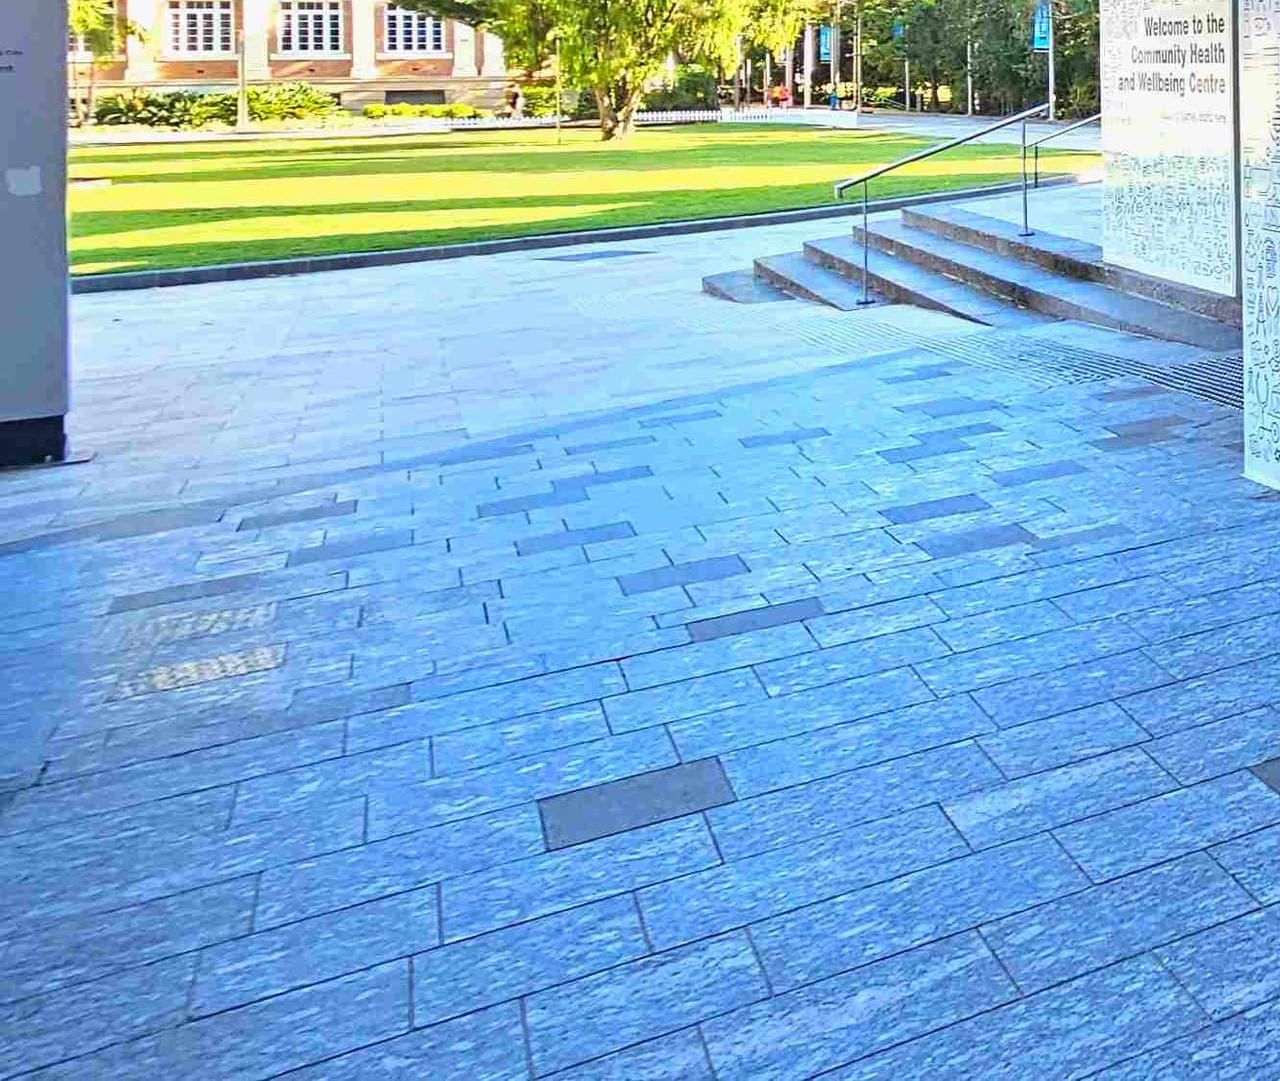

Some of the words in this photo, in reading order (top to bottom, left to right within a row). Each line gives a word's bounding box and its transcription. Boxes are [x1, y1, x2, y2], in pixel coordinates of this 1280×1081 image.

[1143, 16, 1189, 37] Welcome
[1192, 14, 1203, 35] to
[1206, 12, 1225, 34] the
[1131, 44, 1187, 69] Community
[1190, 42, 1225, 64] Health
[1118, 72, 1136, 91] and
[1138, 71, 1185, 98] Wellbeing
[1189, 72, 1226, 94] Centre
